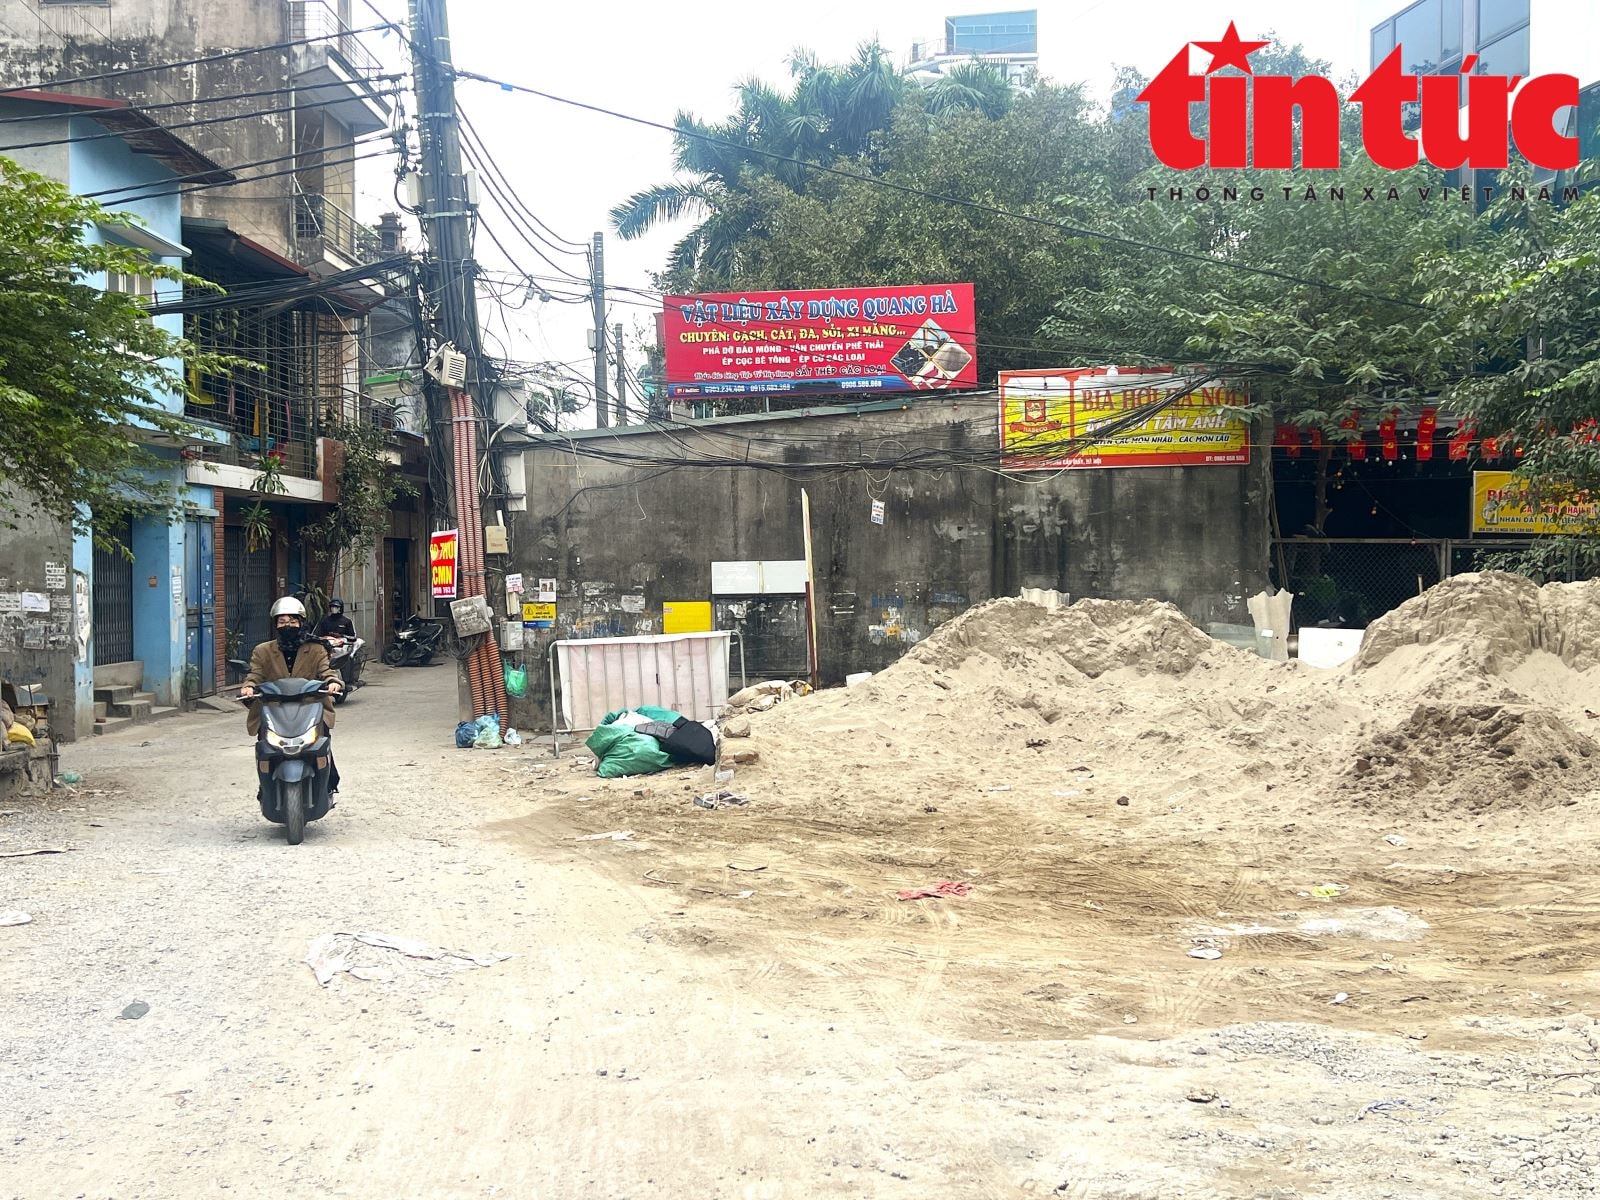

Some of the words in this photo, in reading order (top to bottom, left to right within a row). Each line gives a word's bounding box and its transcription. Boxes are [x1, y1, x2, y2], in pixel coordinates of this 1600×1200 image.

[680, 299, 718, 327] VẬT
[721, 298, 761, 326] LIỆU
[766, 296, 803, 320] XÂY
[808, 297, 858, 323] DỰNG
[863, 296, 927, 320] QUANG
[931, 290, 957, 314] HÀ
[680, 329, 730, 343] CHUYÊN:
[770, 326, 797, 342] CÁT,
[847, 326, 860, 338] XI
[703, 346, 720, 354] PHÁ
[756, 344, 782, 353] MÓNG
[722, 356, 733, 365] ÉP
[736, 357, 753, 366] CỌC
[768, 355, 791, 364] TÔNG
[846, 353, 865, 362] LOẠI
[1081, 388, 1114, 411] BIA
[1153, 413, 1189, 431] TÂM
[1192, 415, 1228, 430] ANH
